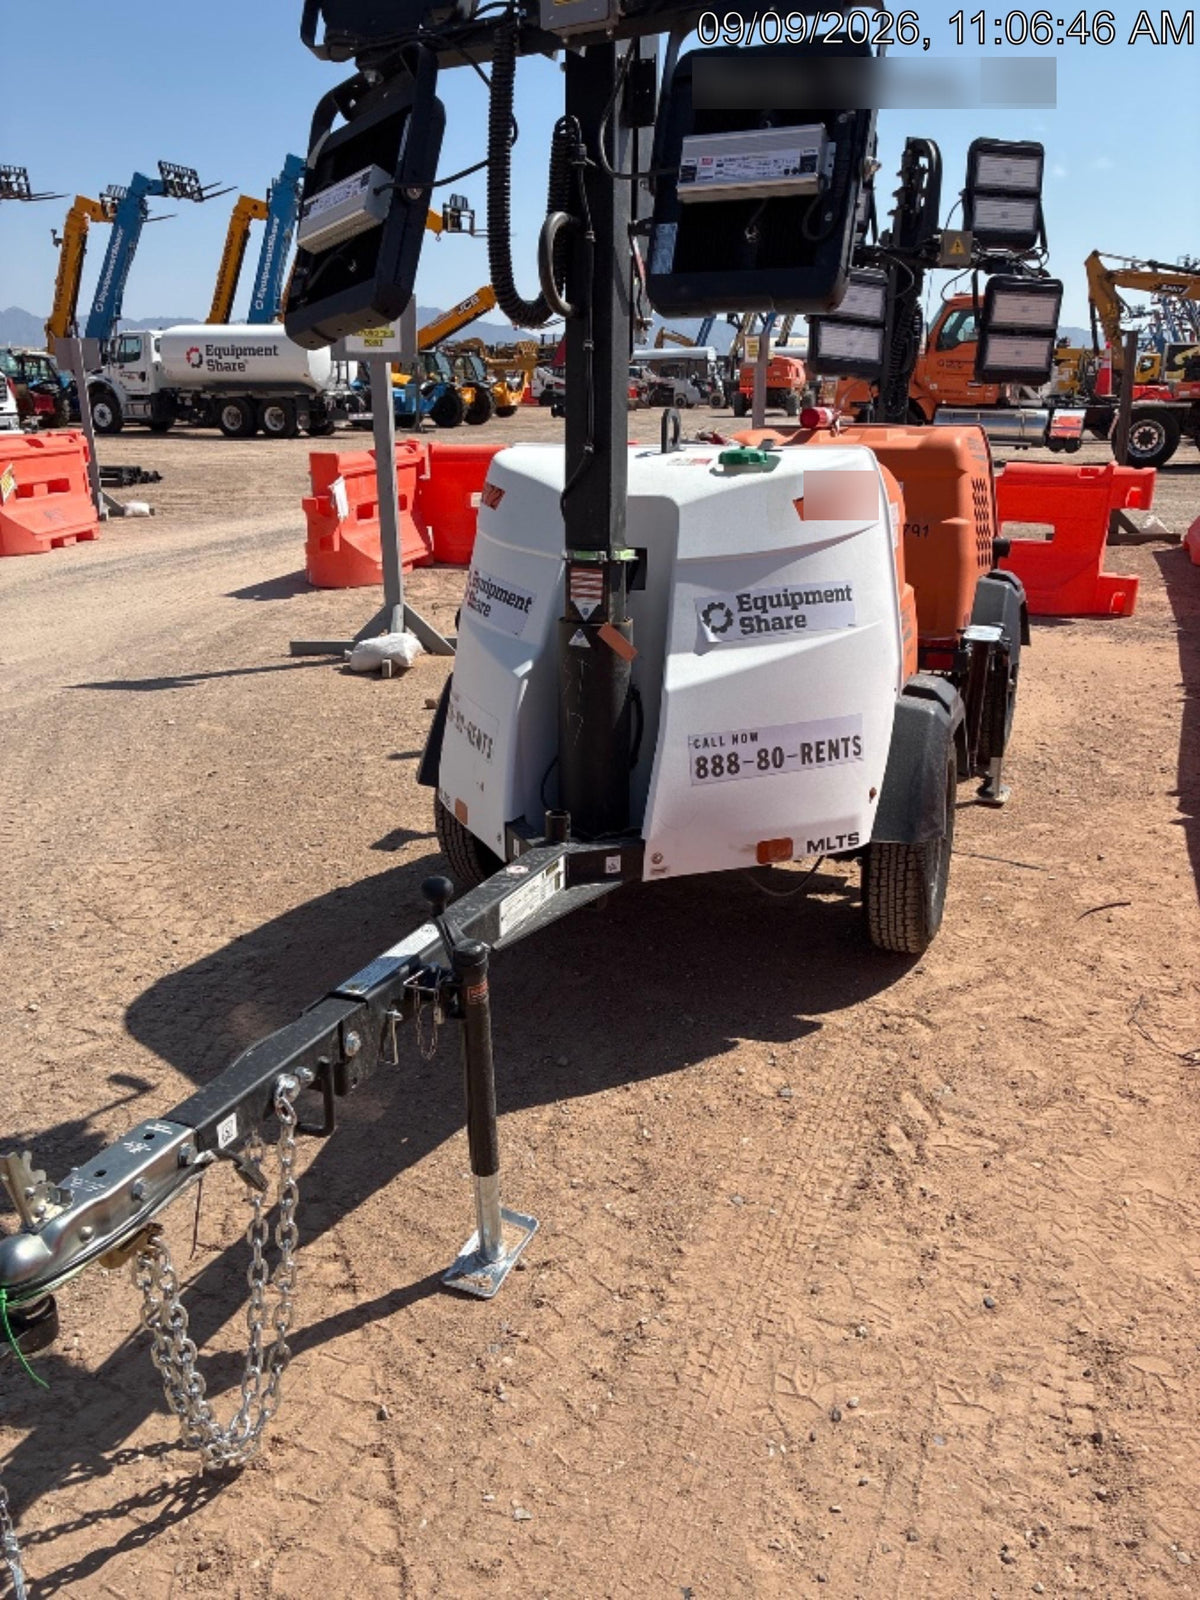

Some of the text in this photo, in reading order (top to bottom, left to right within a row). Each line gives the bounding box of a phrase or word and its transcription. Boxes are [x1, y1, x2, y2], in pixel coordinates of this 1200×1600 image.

[457, 293, 481, 316] JCB
[205, 344, 279, 358] Equipment
[207, 358, 246, 372] Share
[736, 585, 853, 614] Equipment
[739, 614, 807, 635] Share
[694, 732, 758, 749] CALL NOW
[695, 735, 862, 779] 888-80-RENTS
[806, 832, 860, 854] MLTS
